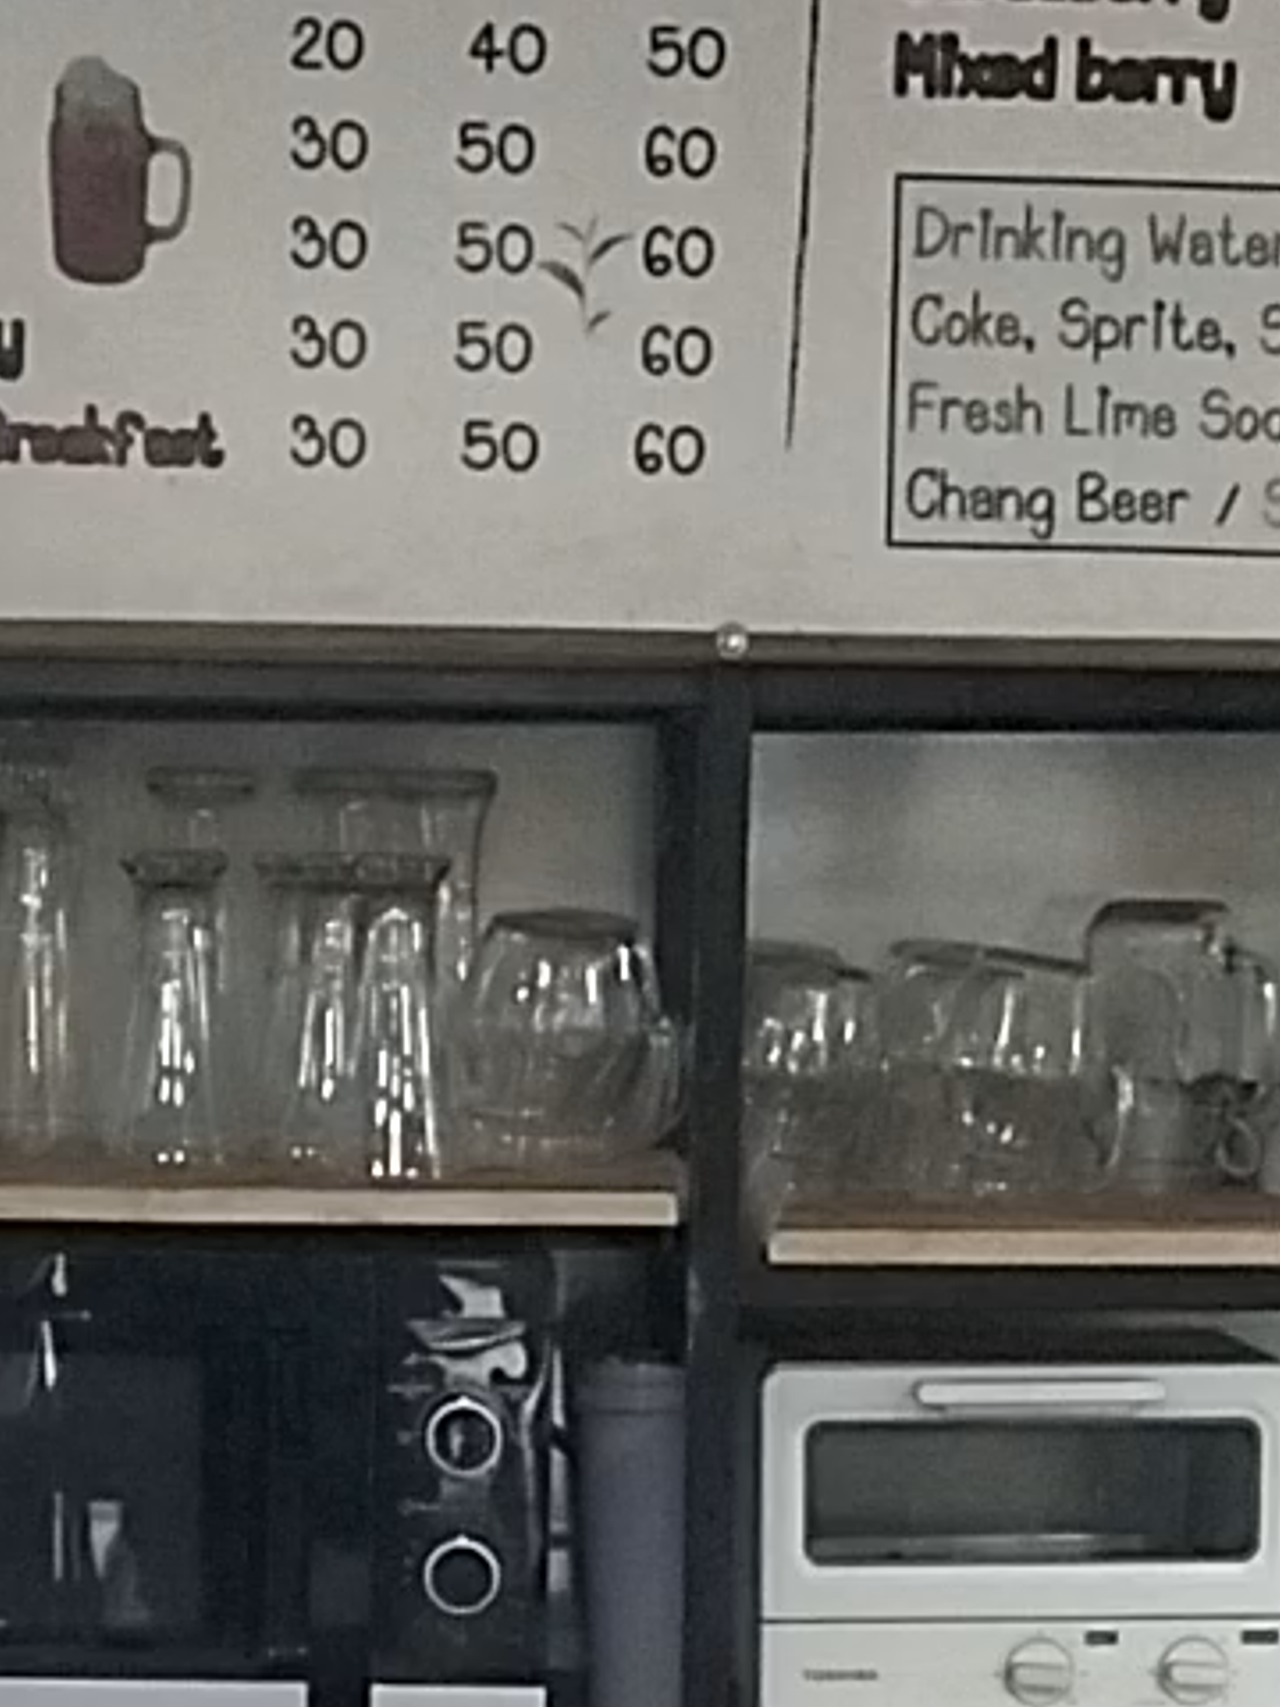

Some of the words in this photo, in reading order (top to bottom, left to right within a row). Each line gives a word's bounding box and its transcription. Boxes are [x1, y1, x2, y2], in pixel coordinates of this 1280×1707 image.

[290, 16, 365, 71] 20
[468, 21, 547, 76] 40
[646, 25, 726, 80] 50
[893, 30, 1059, 102] Mixed
[1075, 36, 1237, 123] berry
[290, 115, 369, 172] 30
[456, 121, 536, 176] 50
[645, 124, 717, 180] 60
[290, 215, 368, 271] 30
[455, 221, 534, 275] 50
[642, 225, 715, 279] 60
[913, 202, 1126, 283] Drinking
[290, 314, 367, 370] 30
[454, 321, 533, 374] 50
[641, 323, 713, 377] 60
[910, 290, 1036, 354] Coke,
[1058, 297, 1236, 364] Sprite,
[908, 379, 1043, 435] Fresh
[1065, 383, 1177, 439] Lime
[290, 414, 367, 469] 30
[461, 419, 539, 473] 50
[634, 422, 706, 476] 60
[905, 467, 1056, 541] Chang
[1077, 470, 1190, 525] Beer
